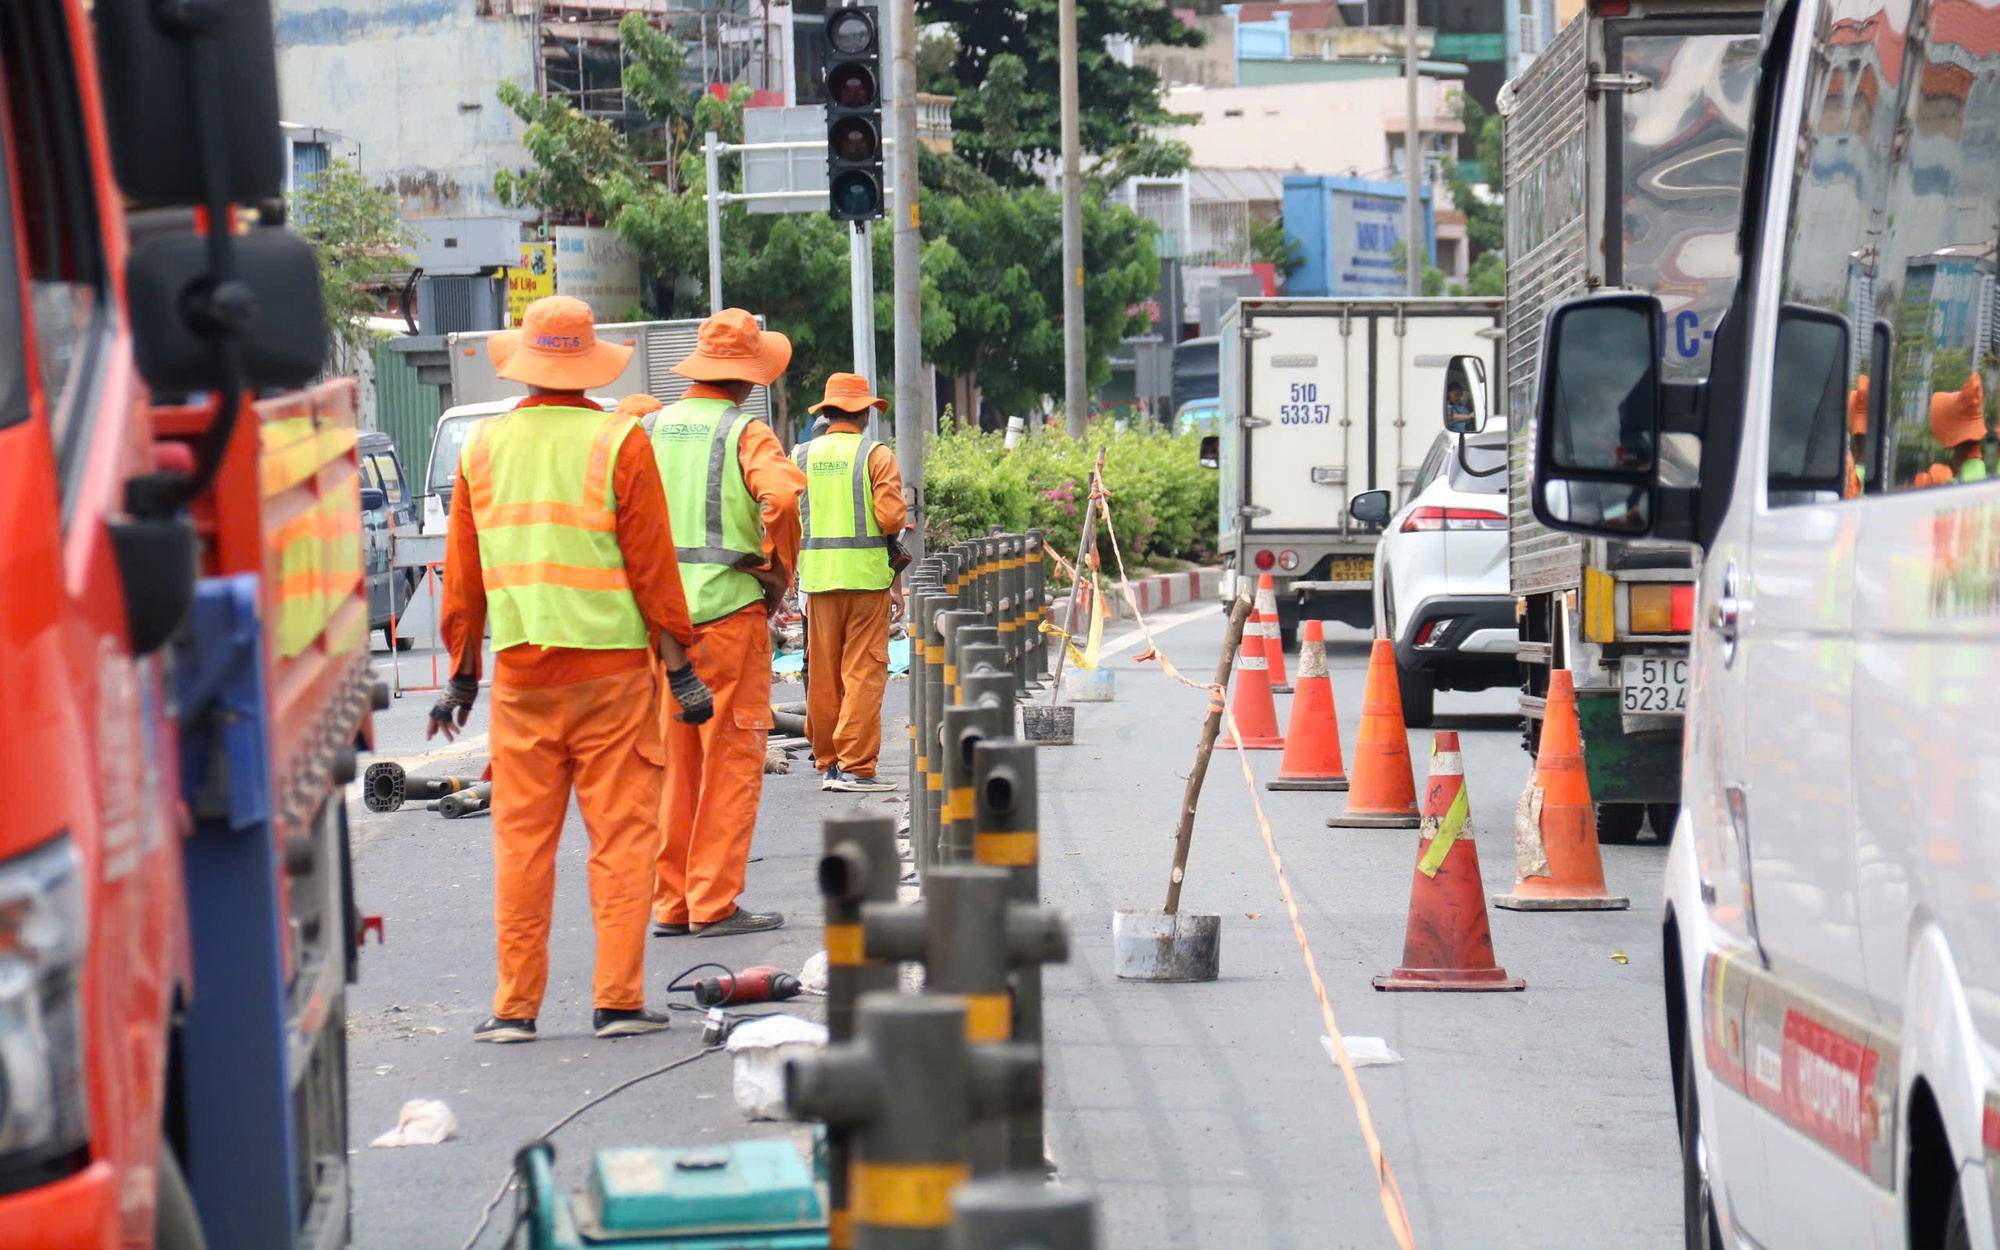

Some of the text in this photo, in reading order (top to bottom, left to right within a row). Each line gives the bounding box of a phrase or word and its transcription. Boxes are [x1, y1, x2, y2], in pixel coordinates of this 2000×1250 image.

[1291, 383, 1317, 403] 51D
[1281, 404, 1330, 425] 533.57
[1642, 659, 1688, 685] 51C
